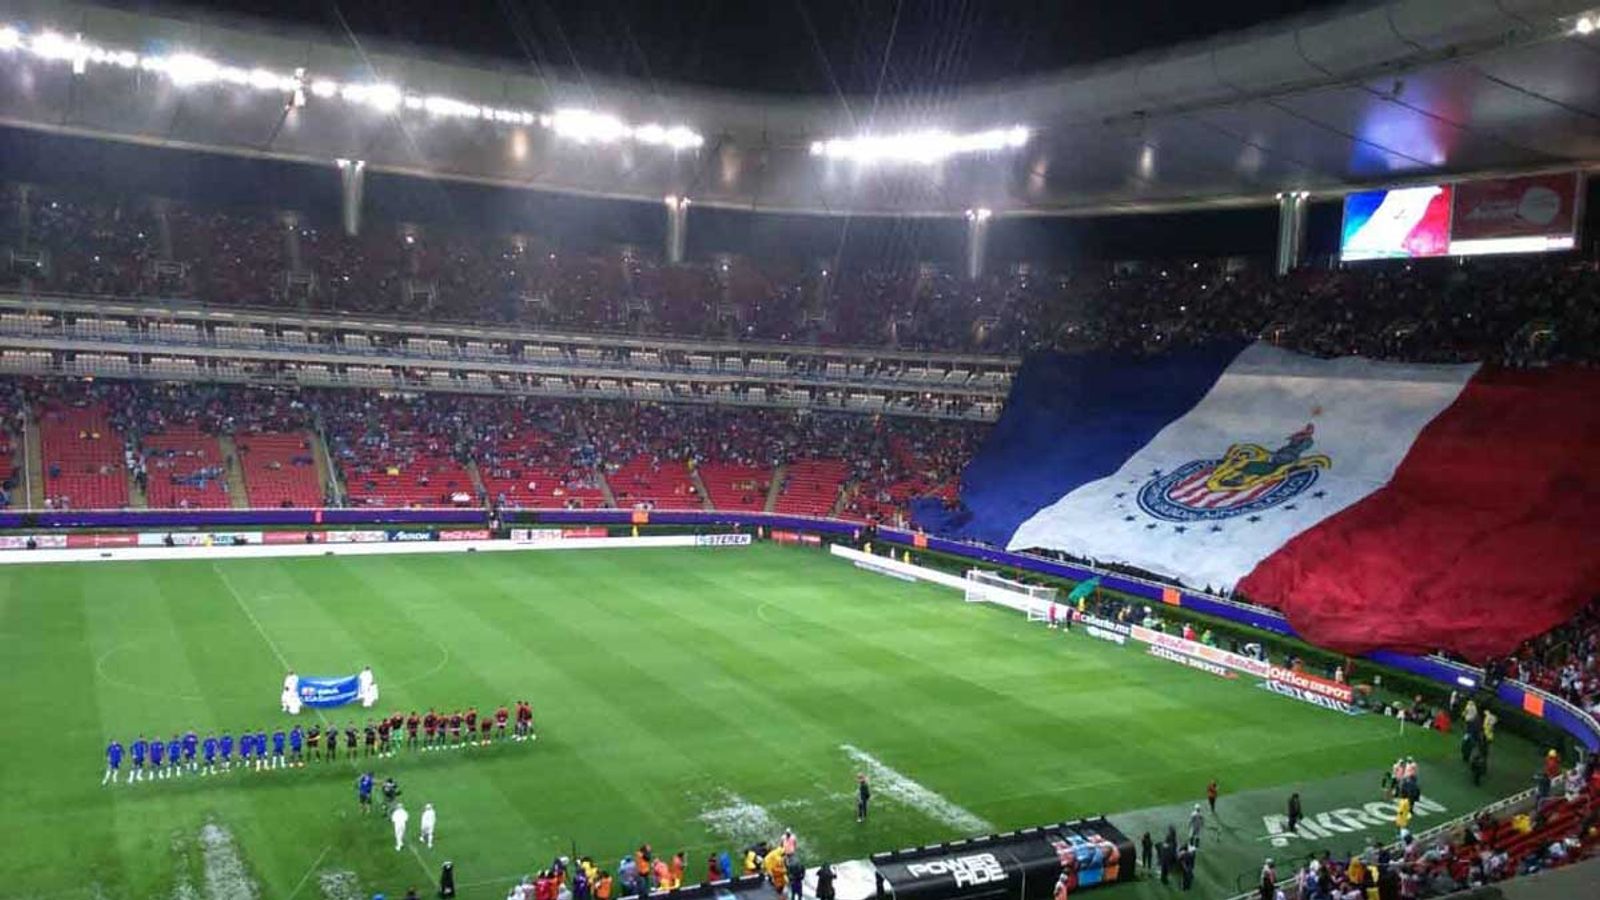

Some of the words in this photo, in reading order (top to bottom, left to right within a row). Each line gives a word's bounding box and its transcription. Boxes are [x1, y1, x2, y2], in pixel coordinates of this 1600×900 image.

[1270, 666, 1308, 686] Office
[1310, 679, 1350, 699] DEPOT
[907, 853, 997, 878] POWER
[954, 861, 1009, 888] RIDE
